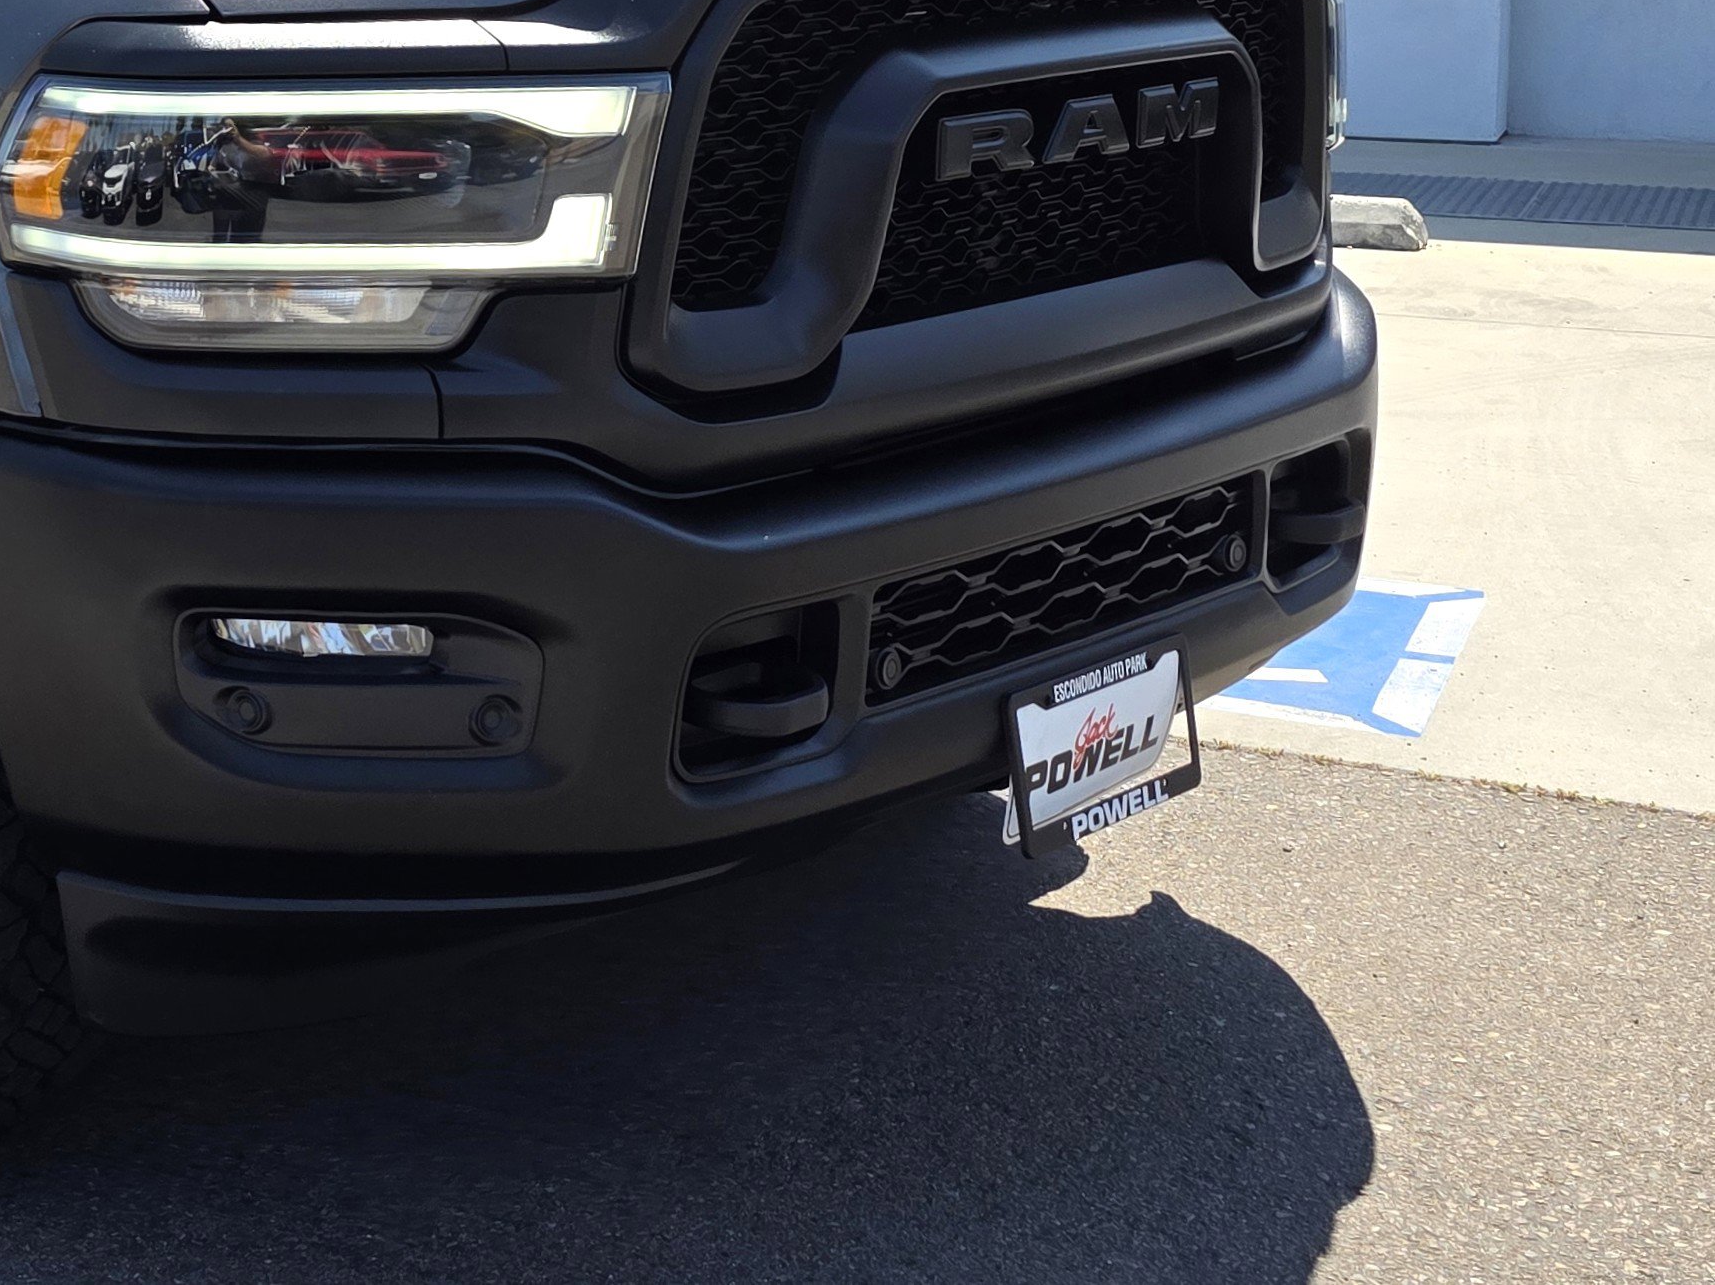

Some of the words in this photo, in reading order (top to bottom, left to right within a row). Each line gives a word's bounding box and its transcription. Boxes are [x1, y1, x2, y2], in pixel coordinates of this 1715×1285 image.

[937, 77, 1218, 181] RAM
[1053, 669, 1102, 703] ESCONDIDO
[1102, 660, 1125, 684] AUTO
[1124, 652, 1148, 676] PARK
[1025, 715, 1159, 794] POWELL
[1073, 703, 1119, 771] Jack
[1072, 779, 1169, 841] POWELL
